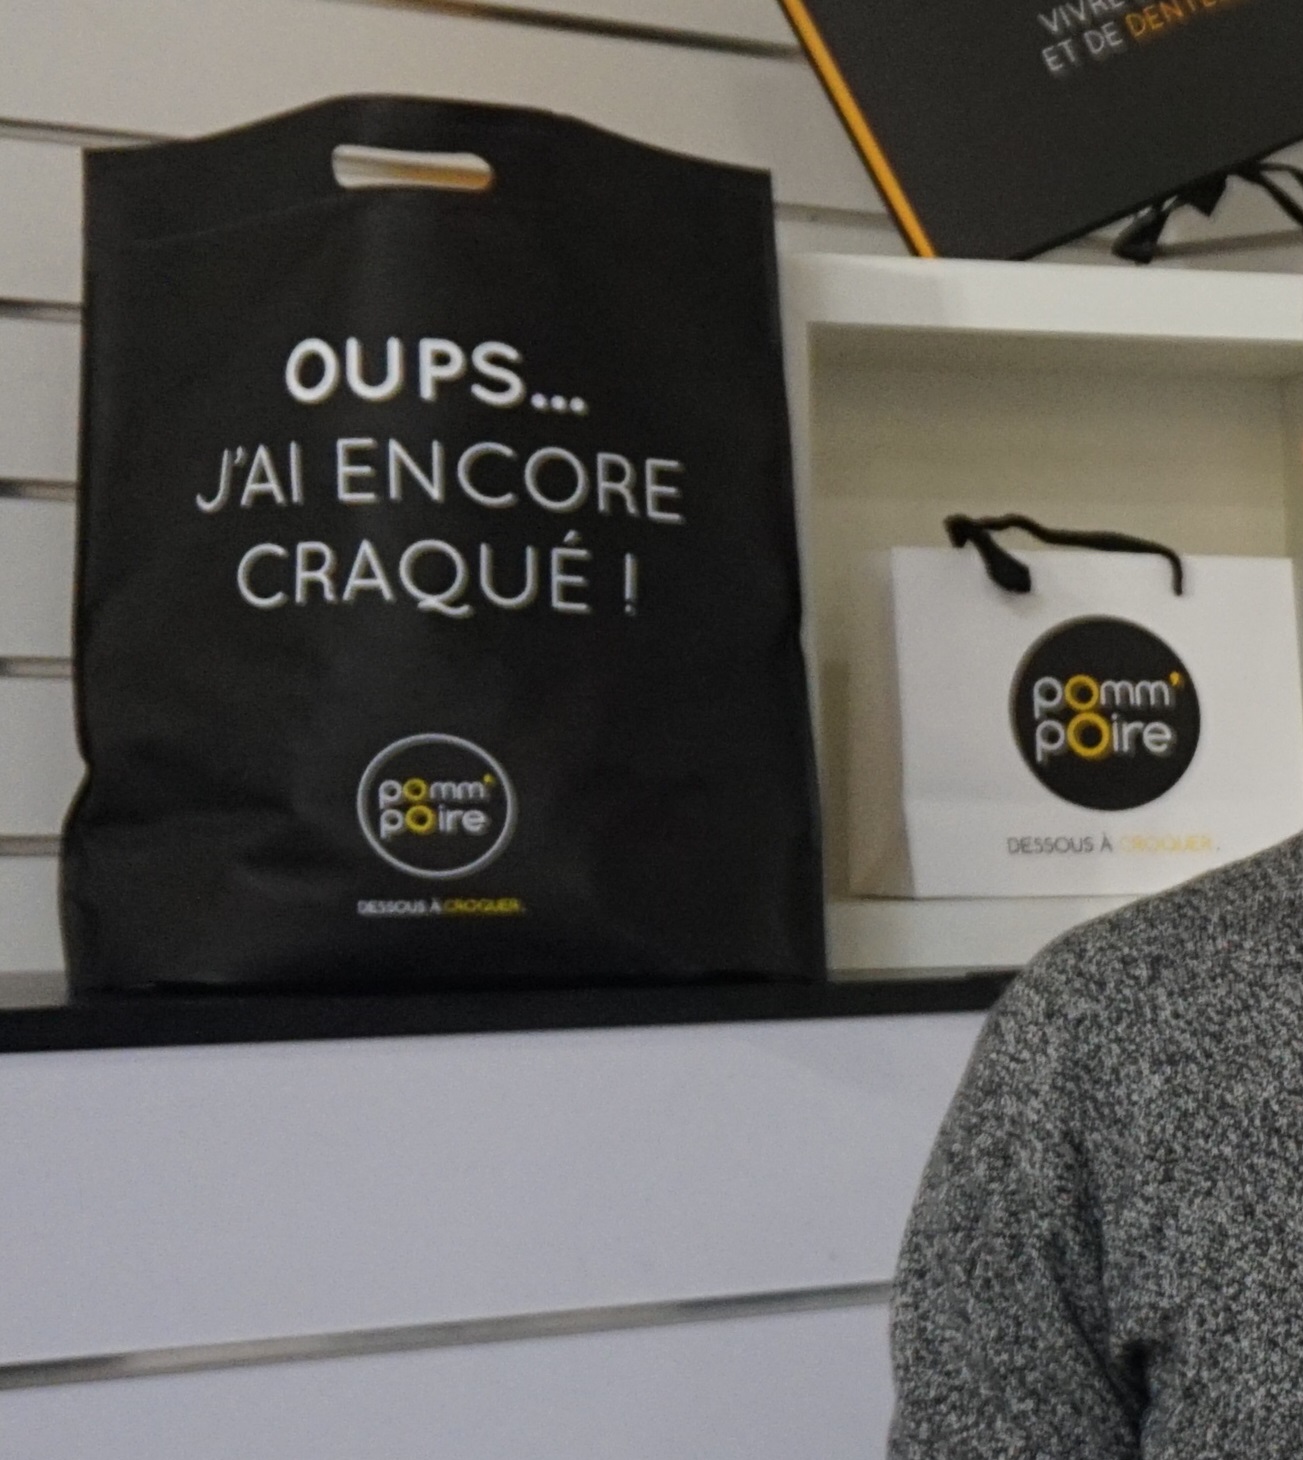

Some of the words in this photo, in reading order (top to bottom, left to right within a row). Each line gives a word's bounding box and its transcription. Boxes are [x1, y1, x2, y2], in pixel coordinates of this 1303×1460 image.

[1042, 39, 1076, 71] ET
[1083, 21, 1123, 55] DE
[284, 337, 588, 414] OUPS...
[196, 440, 303, 512] J'AI
[336, 437, 686, 524] ENCORE
[237, 530, 591, 619] CRAQUÉ
[623, 552, 638, 616] !
[1035, 712, 1173, 764] poire
[380, 803, 488, 839] poire
[1007, 836, 1094, 855] DESSOUS
[357, 899, 426, 914] DESSOUS
